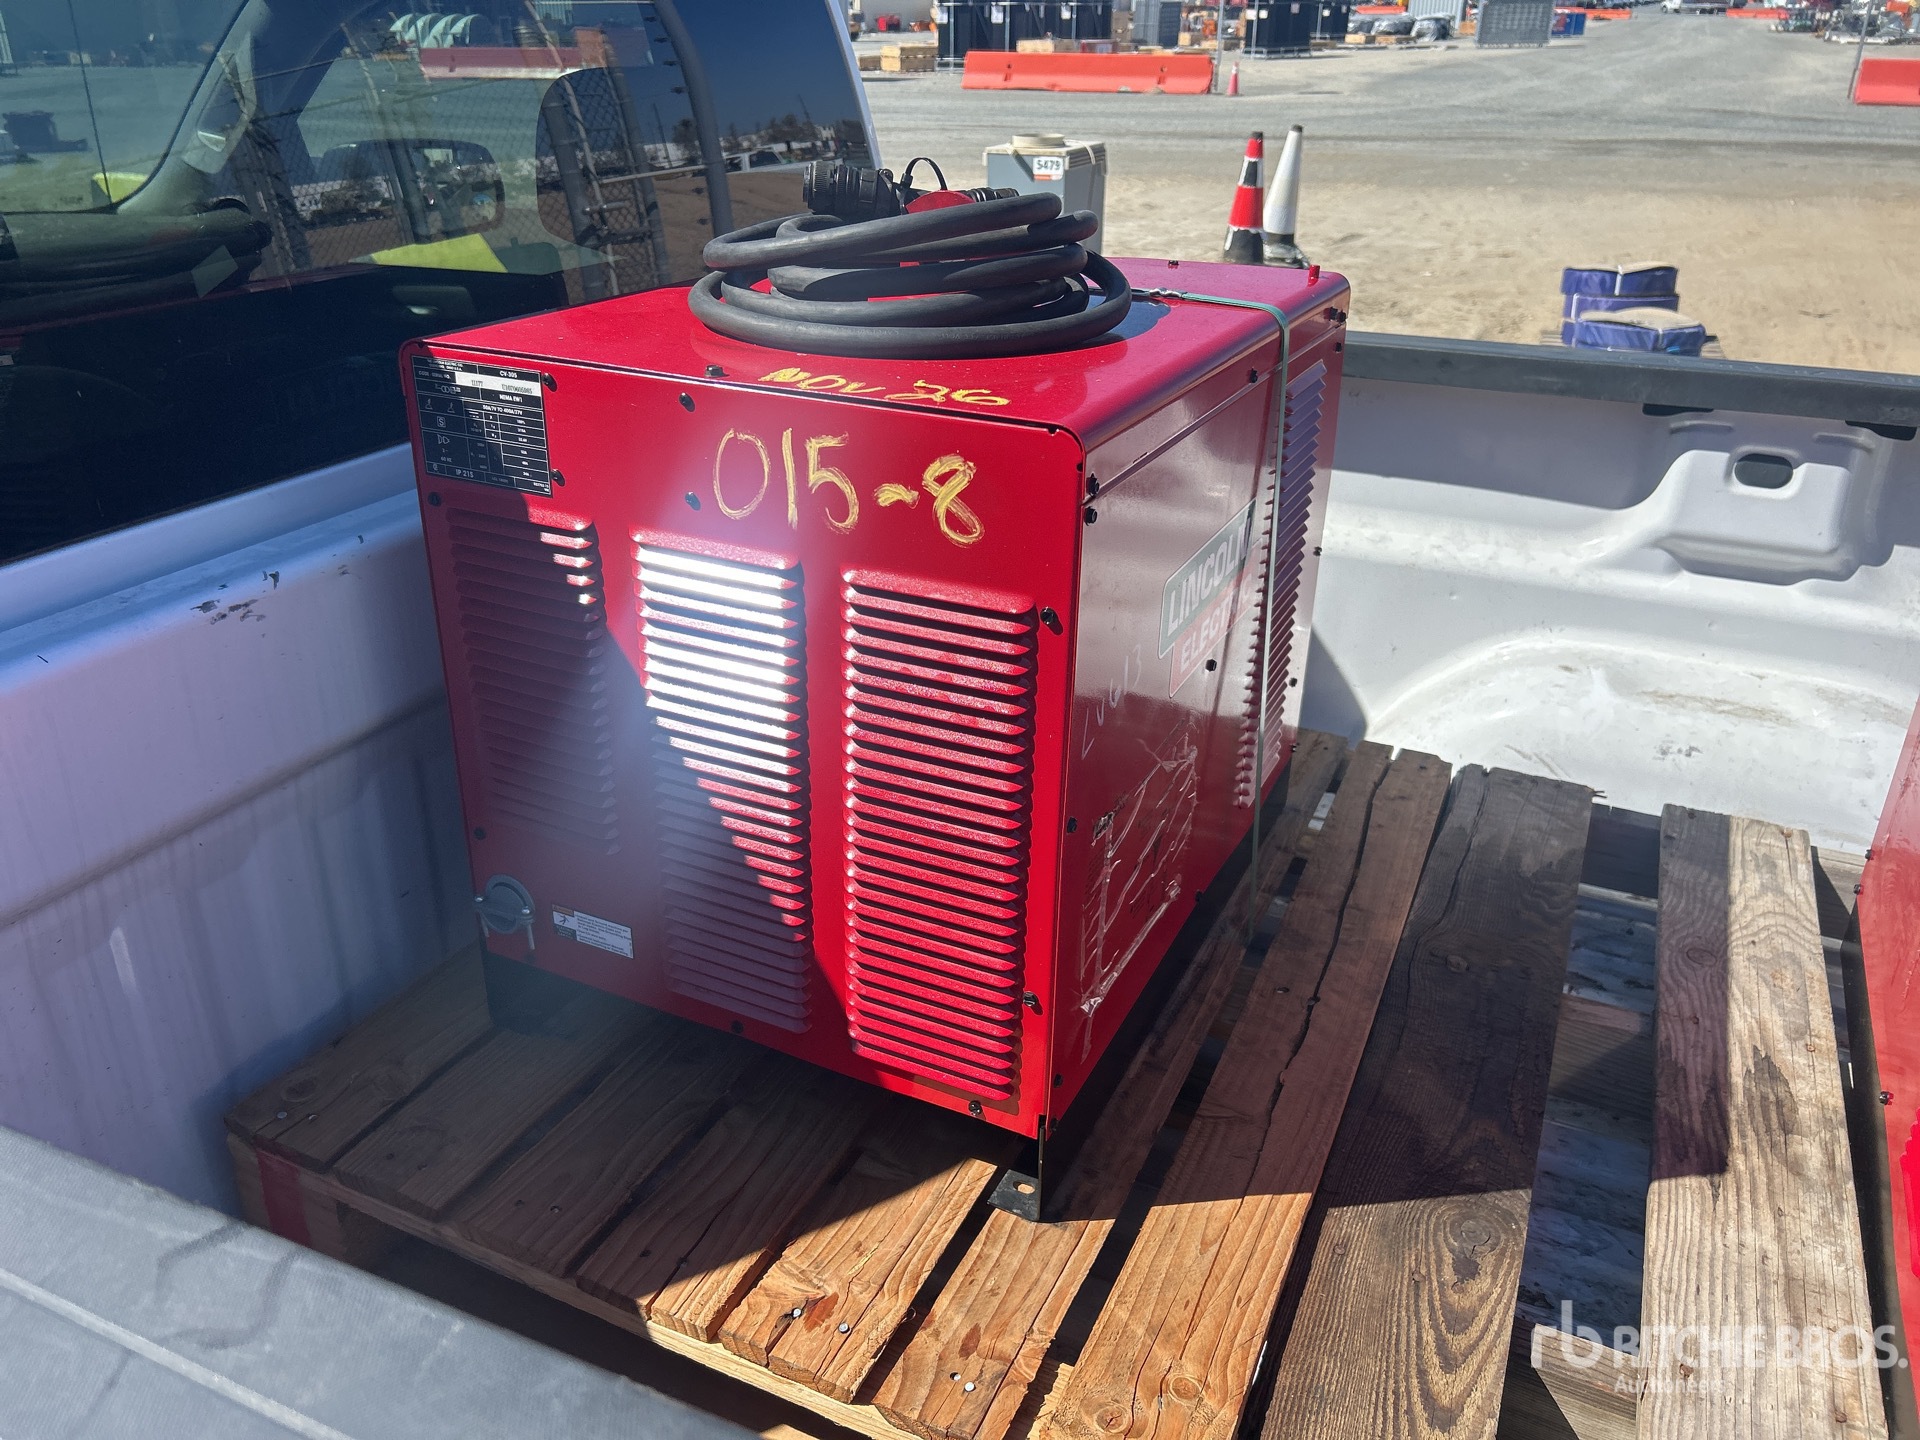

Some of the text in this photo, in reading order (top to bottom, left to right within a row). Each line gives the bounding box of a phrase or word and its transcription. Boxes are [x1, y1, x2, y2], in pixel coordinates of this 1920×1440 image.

[1036, 159, 1061, 171] 5479
[758, 367, 1011, 406] NOV 26
[713, 427, 986, 548] 015-8
[1167, 515, 1251, 637] LINCOLN
[1180, 572, 1252, 673] ELECTIC
